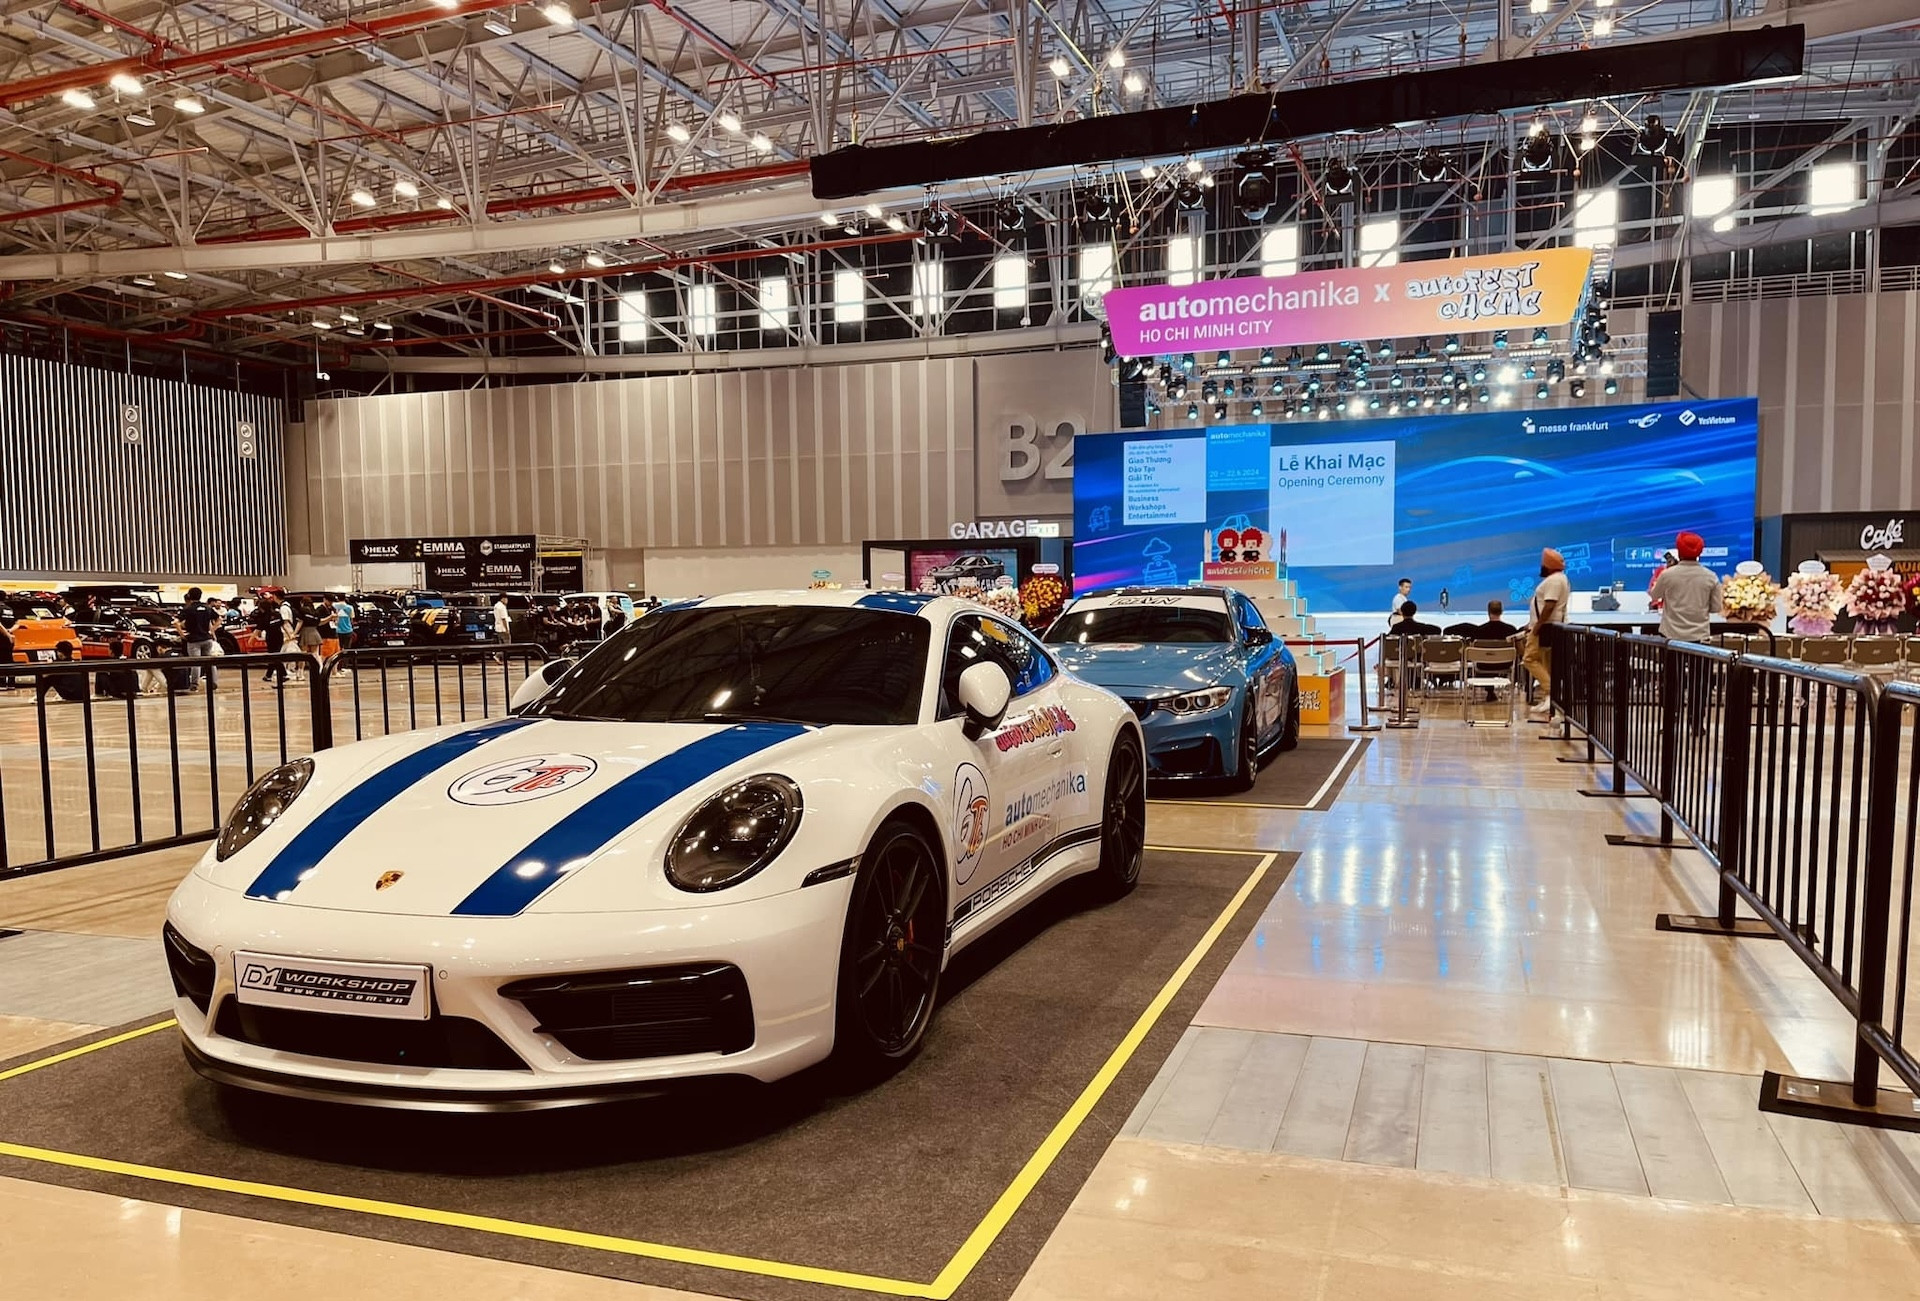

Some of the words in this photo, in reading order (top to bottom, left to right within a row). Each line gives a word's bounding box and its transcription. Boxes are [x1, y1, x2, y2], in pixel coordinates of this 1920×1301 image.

[1139, 281, 1359, 322] automechanika
[1439, 289, 1541, 320] @HCMC
[1140, 328, 1161, 343] HO
[1164, 326, 1190, 341] CHI
[1193, 322, 1235, 339] MINH
[1238, 319, 1273, 336] CITY
[1538, 425, 1568, 434] messe
[1569, 421, 1609, 432] frankfurt
[1698, 416, 1736, 425] YesVietnam
[1001, 414, 1086, 481] B2
[1279, 454, 1299, 472] Lễ
[1304, 454, 1342, 471] Khai
[1348, 453, 1386, 471] Mạc
[1279, 476, 1324, 490] Opening
[1327, 474, 1385, 487] Ceremony
[1128, 503, 1166, 511] Workshops
[1128, 511, 1177, 519] Entertainment
[950, 520, 1038, 540] GARAGE
[1861, 519, 1904, 550] Café
[369, 544, 400, 555] HELIX
[423, 542, 466, 552] EMMA
[441, 567, 467, 575] HELIX
[486, 564, 522, 573] EMMA
[1005, 770, 1086, 827] automechanika
[1002, 832, 1012, 850] HO
[973, 860, 1031, 910] PORSCHE
[241, 964, 281, 993] D1
[285, 972, 411, 992] WORKSHOP
[283, 986, 405, 1004] www.d1.com.vn
